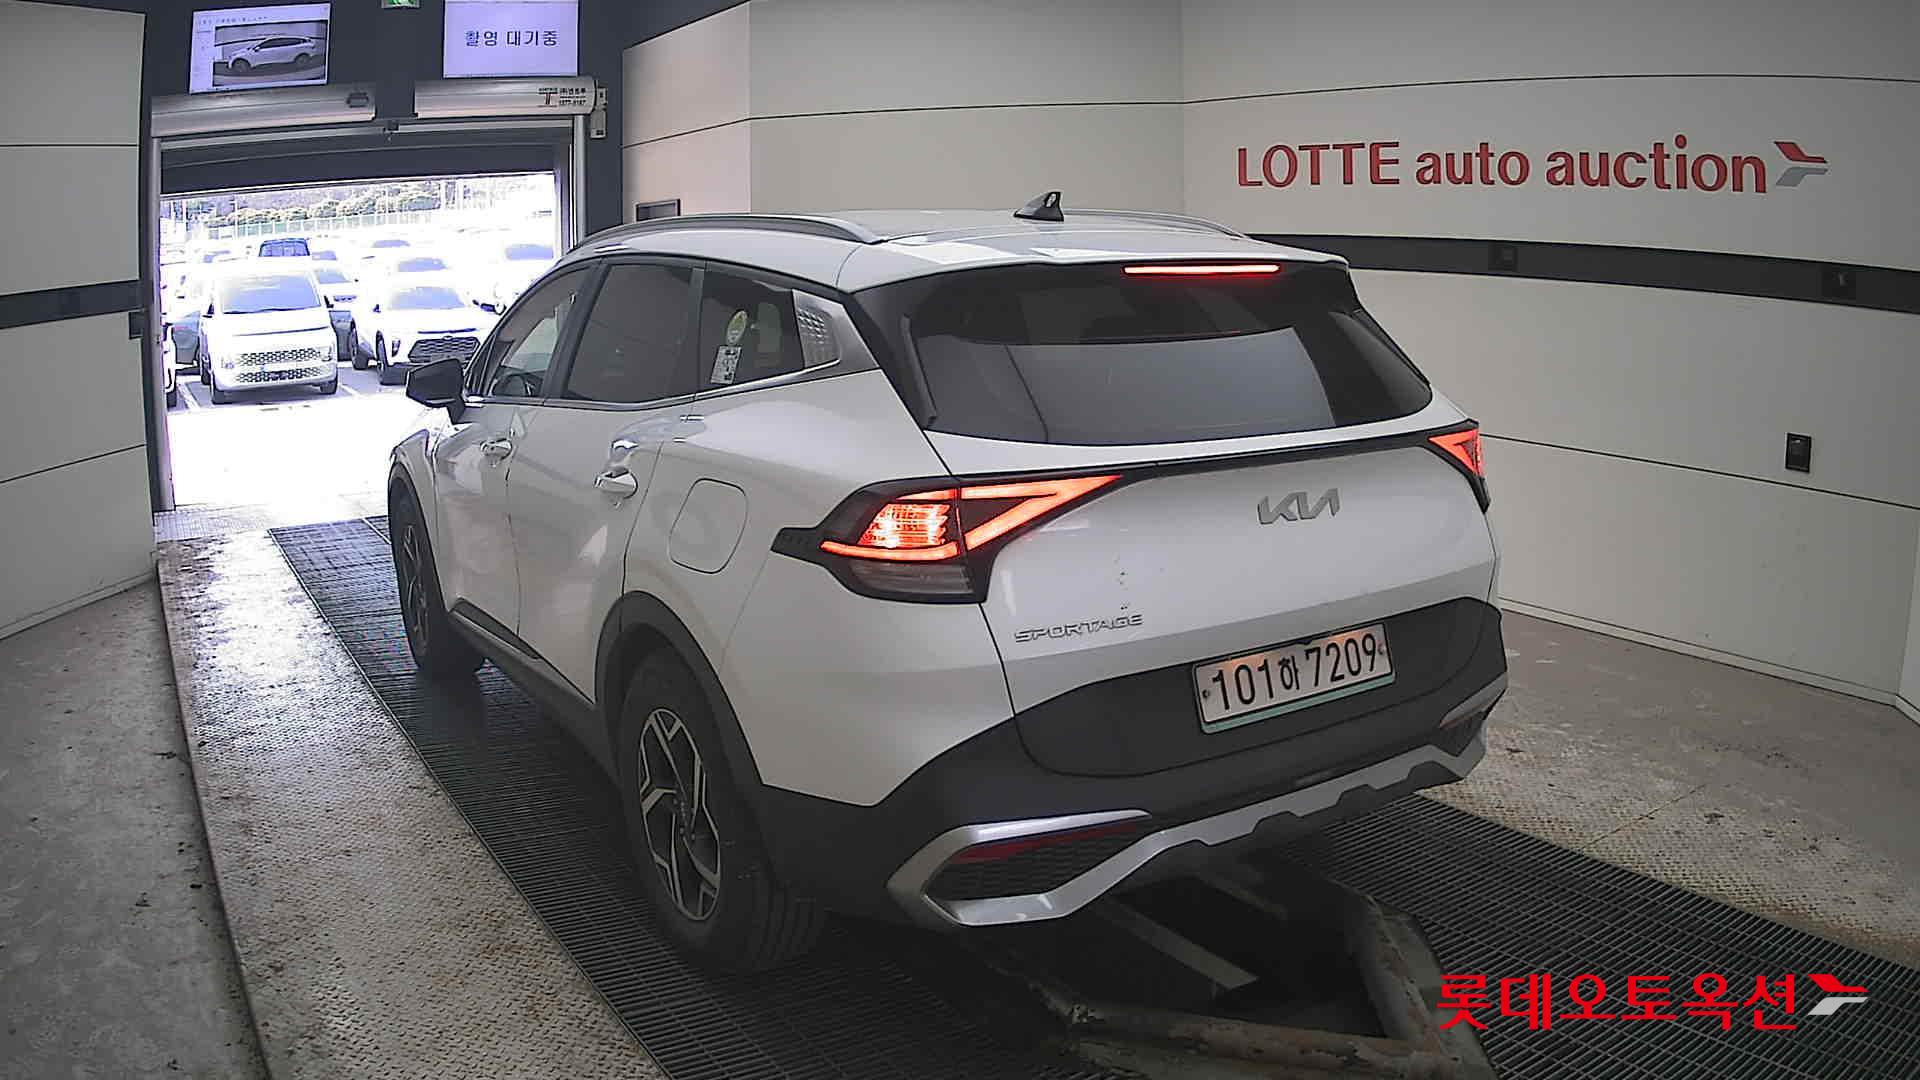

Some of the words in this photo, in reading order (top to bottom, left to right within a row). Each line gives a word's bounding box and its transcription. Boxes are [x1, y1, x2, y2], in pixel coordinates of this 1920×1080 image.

[506, 30, 559, 48] 대기중
[1237, 141, 1401, 188] LOTTE
[1415, 142, 1531, 186] auto
[1546, 134, 1767, 193] auction
[1257, 488, 1341, 525] KIA
[1014, 614, 1144, 643] SPORTAGE
